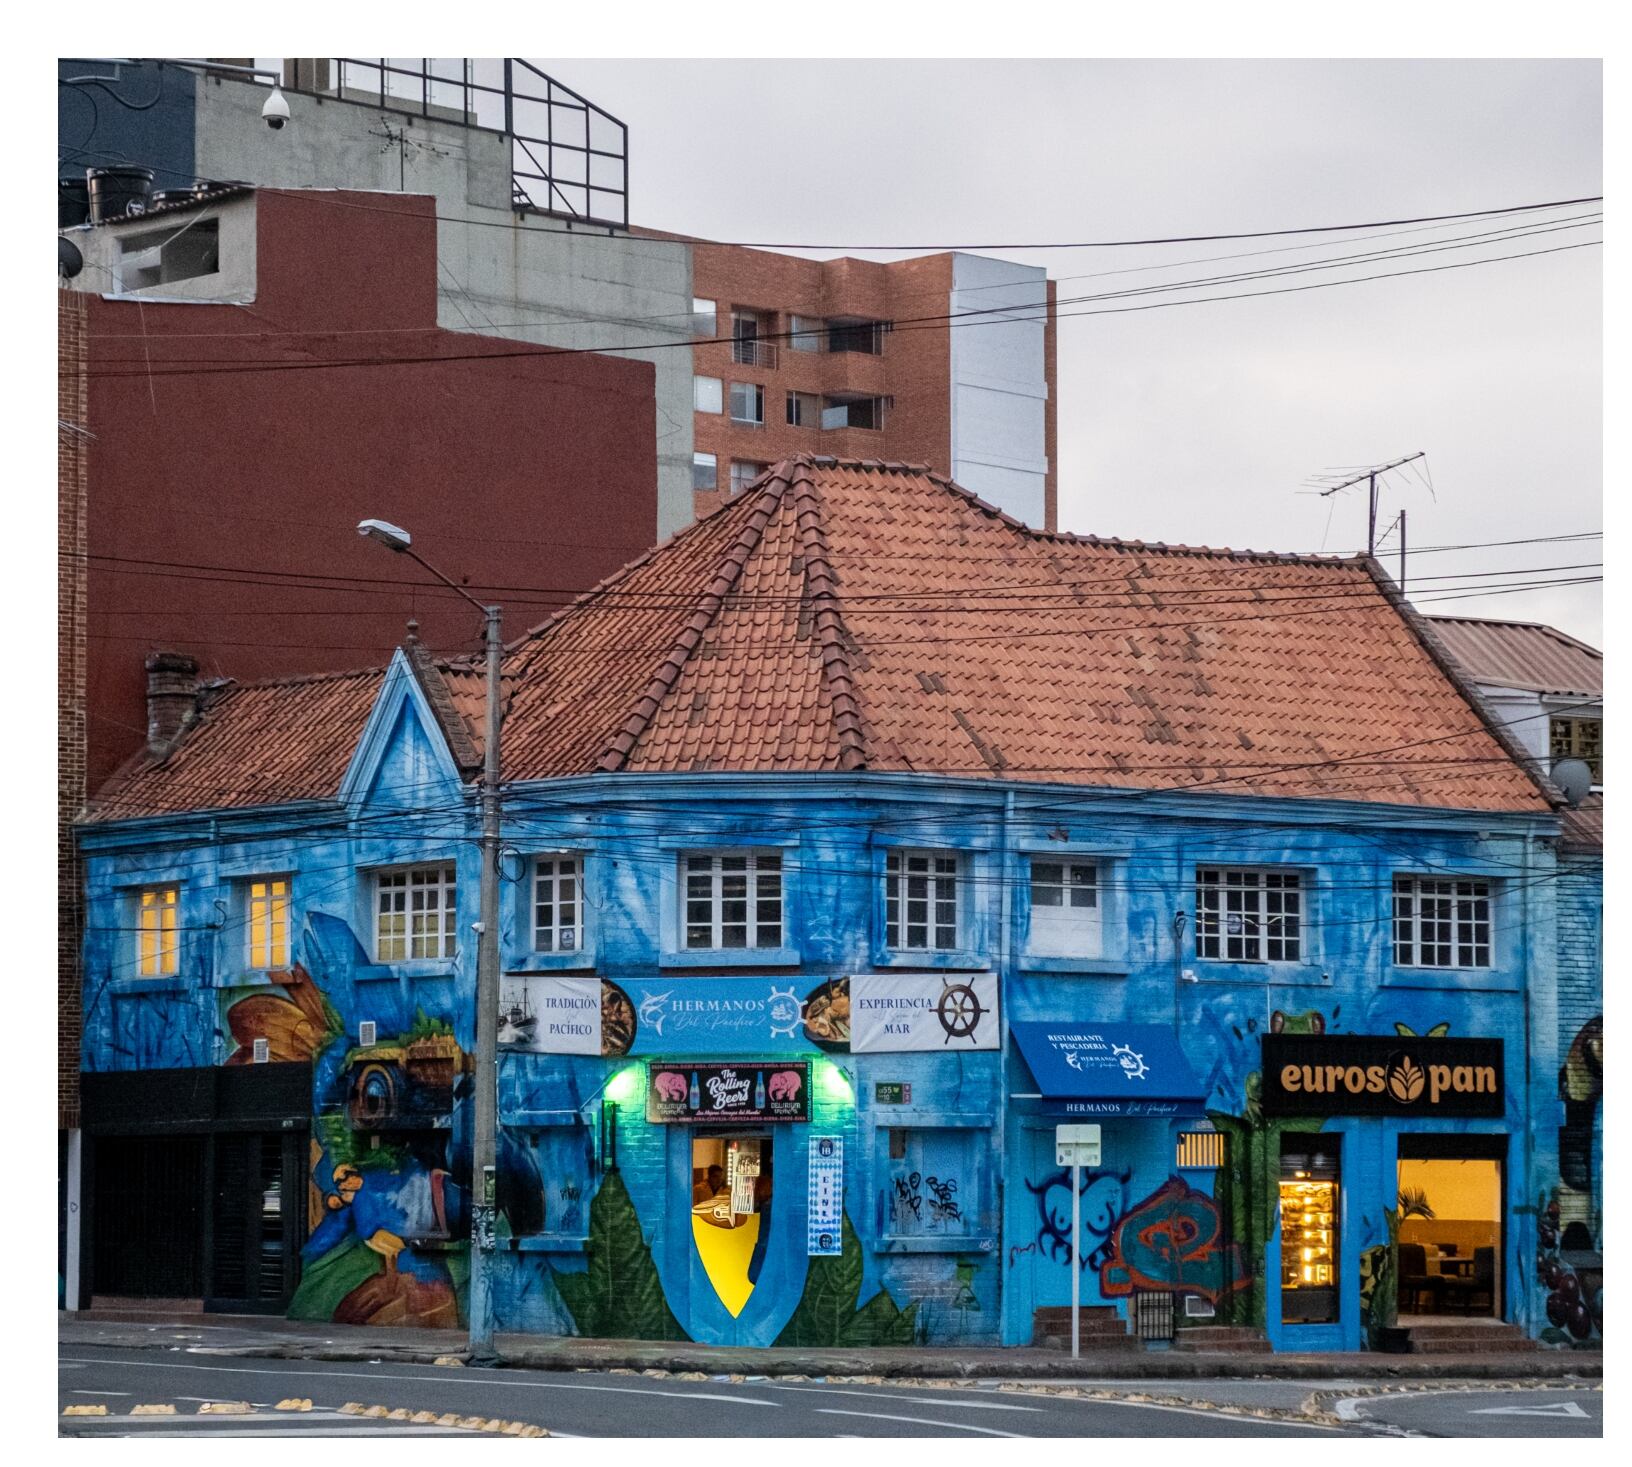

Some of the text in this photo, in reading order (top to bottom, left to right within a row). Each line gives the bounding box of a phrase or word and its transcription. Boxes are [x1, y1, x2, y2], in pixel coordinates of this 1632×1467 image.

[545, 995, 598, 1009] TRADICIÓN
[672, 1000, 765, 1011] HERMANOS
[859, 998, 933, 1009] EXPERIENCIA
[549, 1021, 592, 1035] PACÍFICO
[883, 1023, 910, 1034] MAR
[1048, 1034, 1104, 1042] RESTAURANTE
[721, 1069, 737, 1079] The
[706, 1076, 751, 1095] Rolling
[1281, 1064, 1497, 1103] euros pan
[713, 1090, 749, 1110] Beers
[1066, 1103, 1121, 1112] HERMANOS
